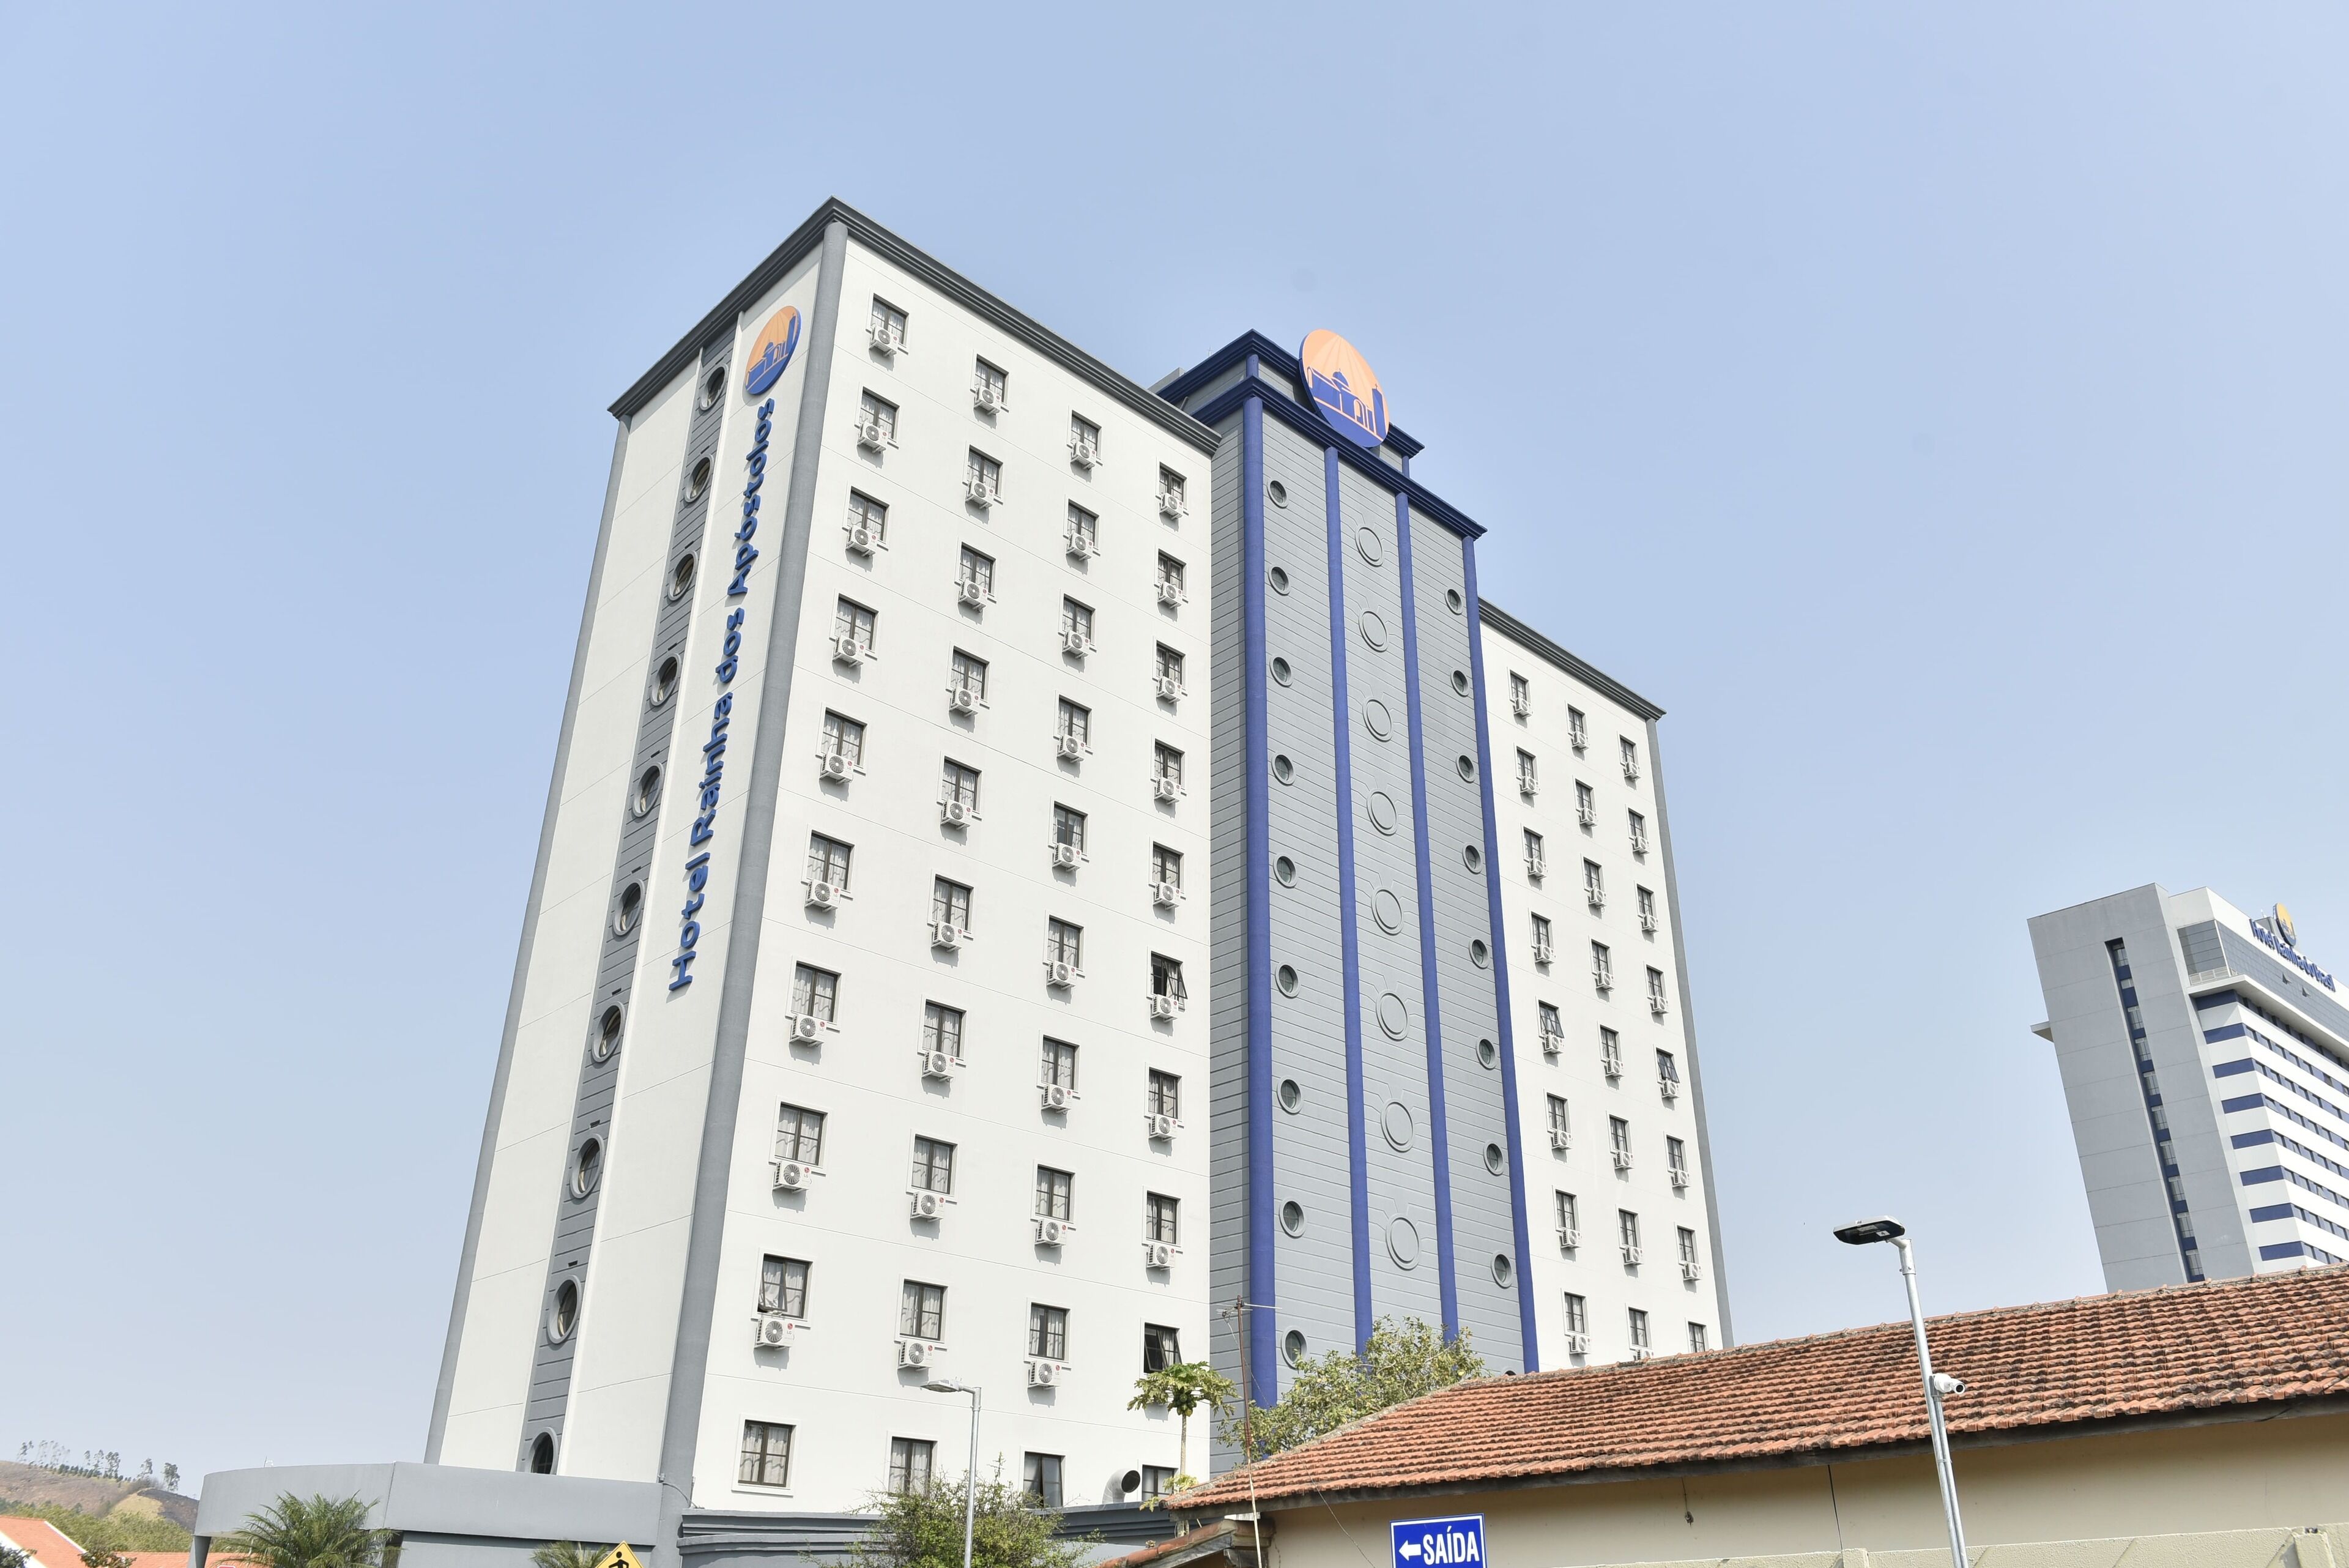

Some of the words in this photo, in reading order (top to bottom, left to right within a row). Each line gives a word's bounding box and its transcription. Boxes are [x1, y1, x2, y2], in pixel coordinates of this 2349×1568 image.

[727, 398, 774, 596] Apóstolos
[715, 607, 745, 683] dos
[690, 692, 733, 847] Rainha
[669, 852, 710, 991] Hotel
[1423, 1526, 1480, 1566] SAÍDA
